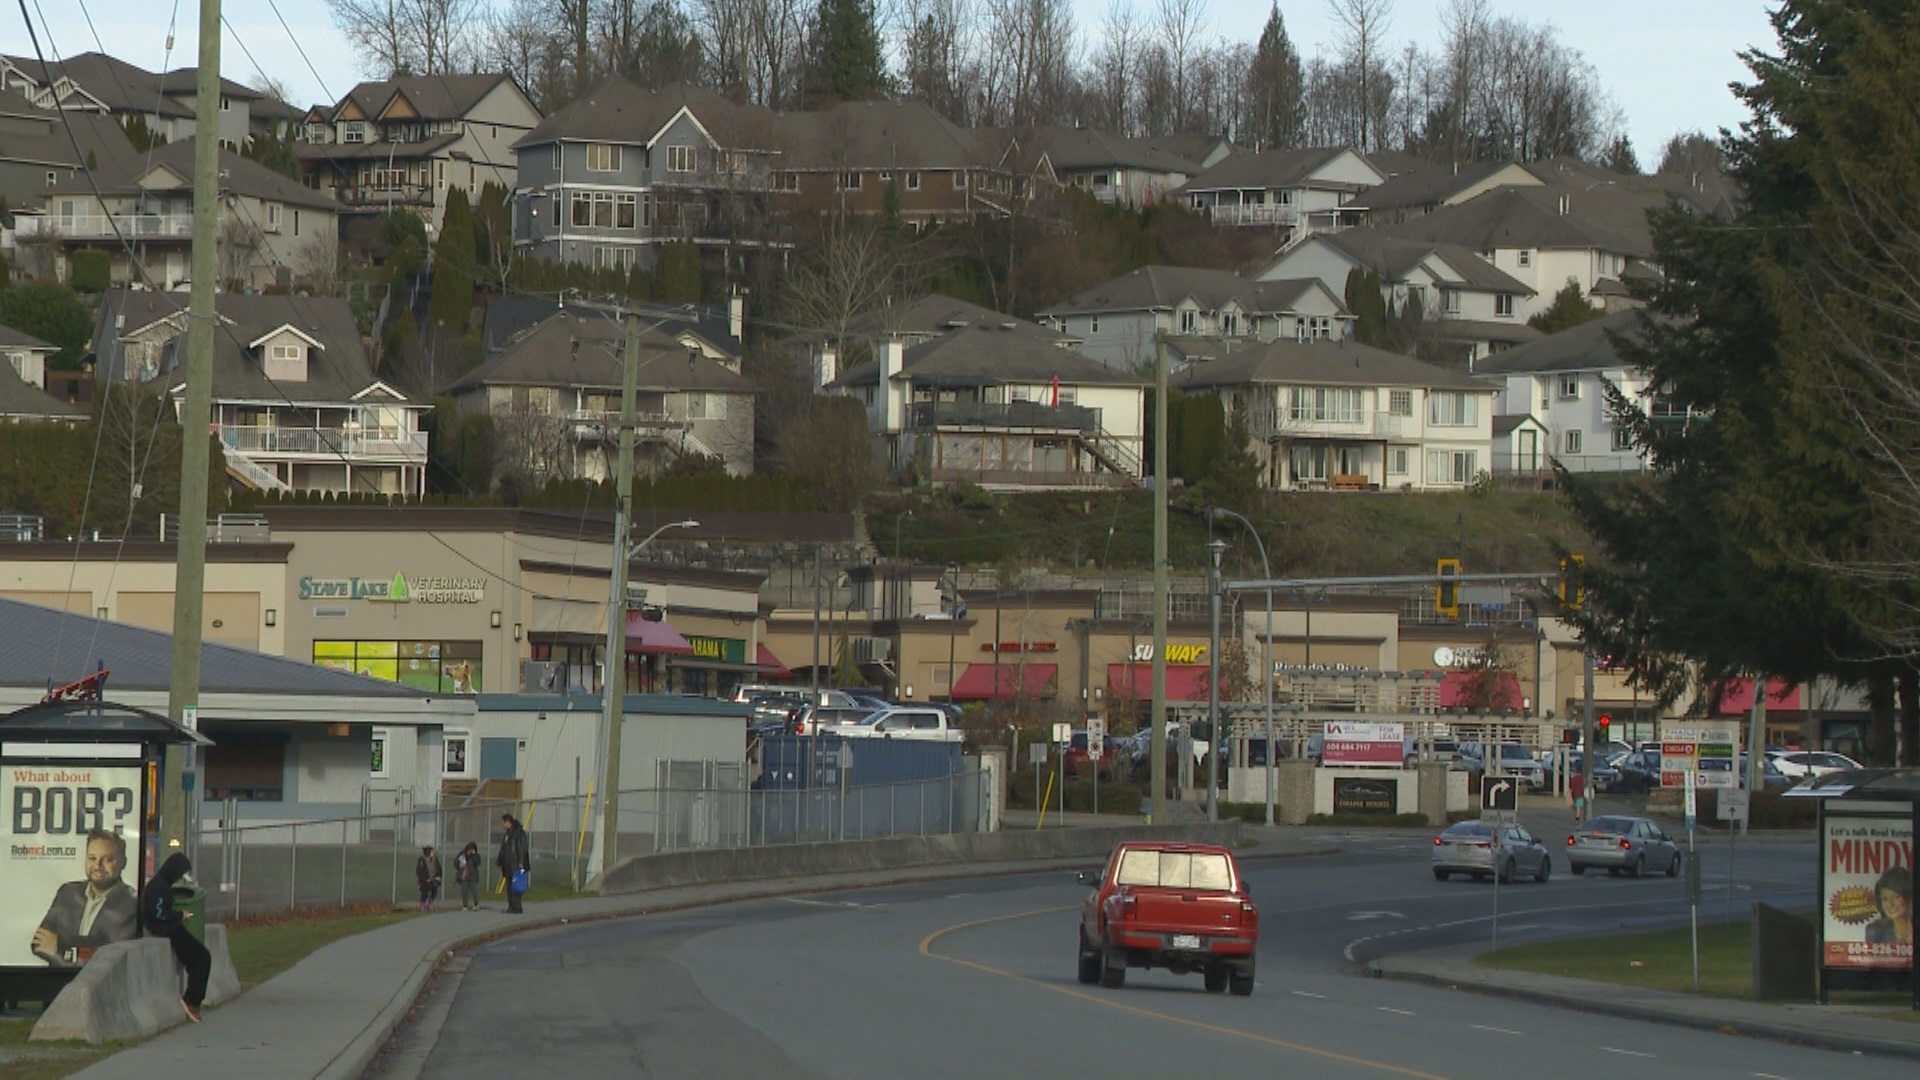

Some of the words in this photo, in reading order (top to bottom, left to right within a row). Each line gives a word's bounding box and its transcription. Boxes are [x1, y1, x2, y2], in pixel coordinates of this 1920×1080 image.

[299, 576, 348, 599] STAVE
[350, 576, 388, 599] LAKE
[410, 577, 486, 590] VETERINARY
[418, 591, 478, 603] HOSPITAL
[1129, 644, 1207, 662] SUWAY
[14, 771, 49, 782] What
[53, 771, 92, 782] about
[12, 785, 133, 836] BOB?
[1831, 827, 1850, 836] Let's
[1852, 828, 1869, 836] talk
